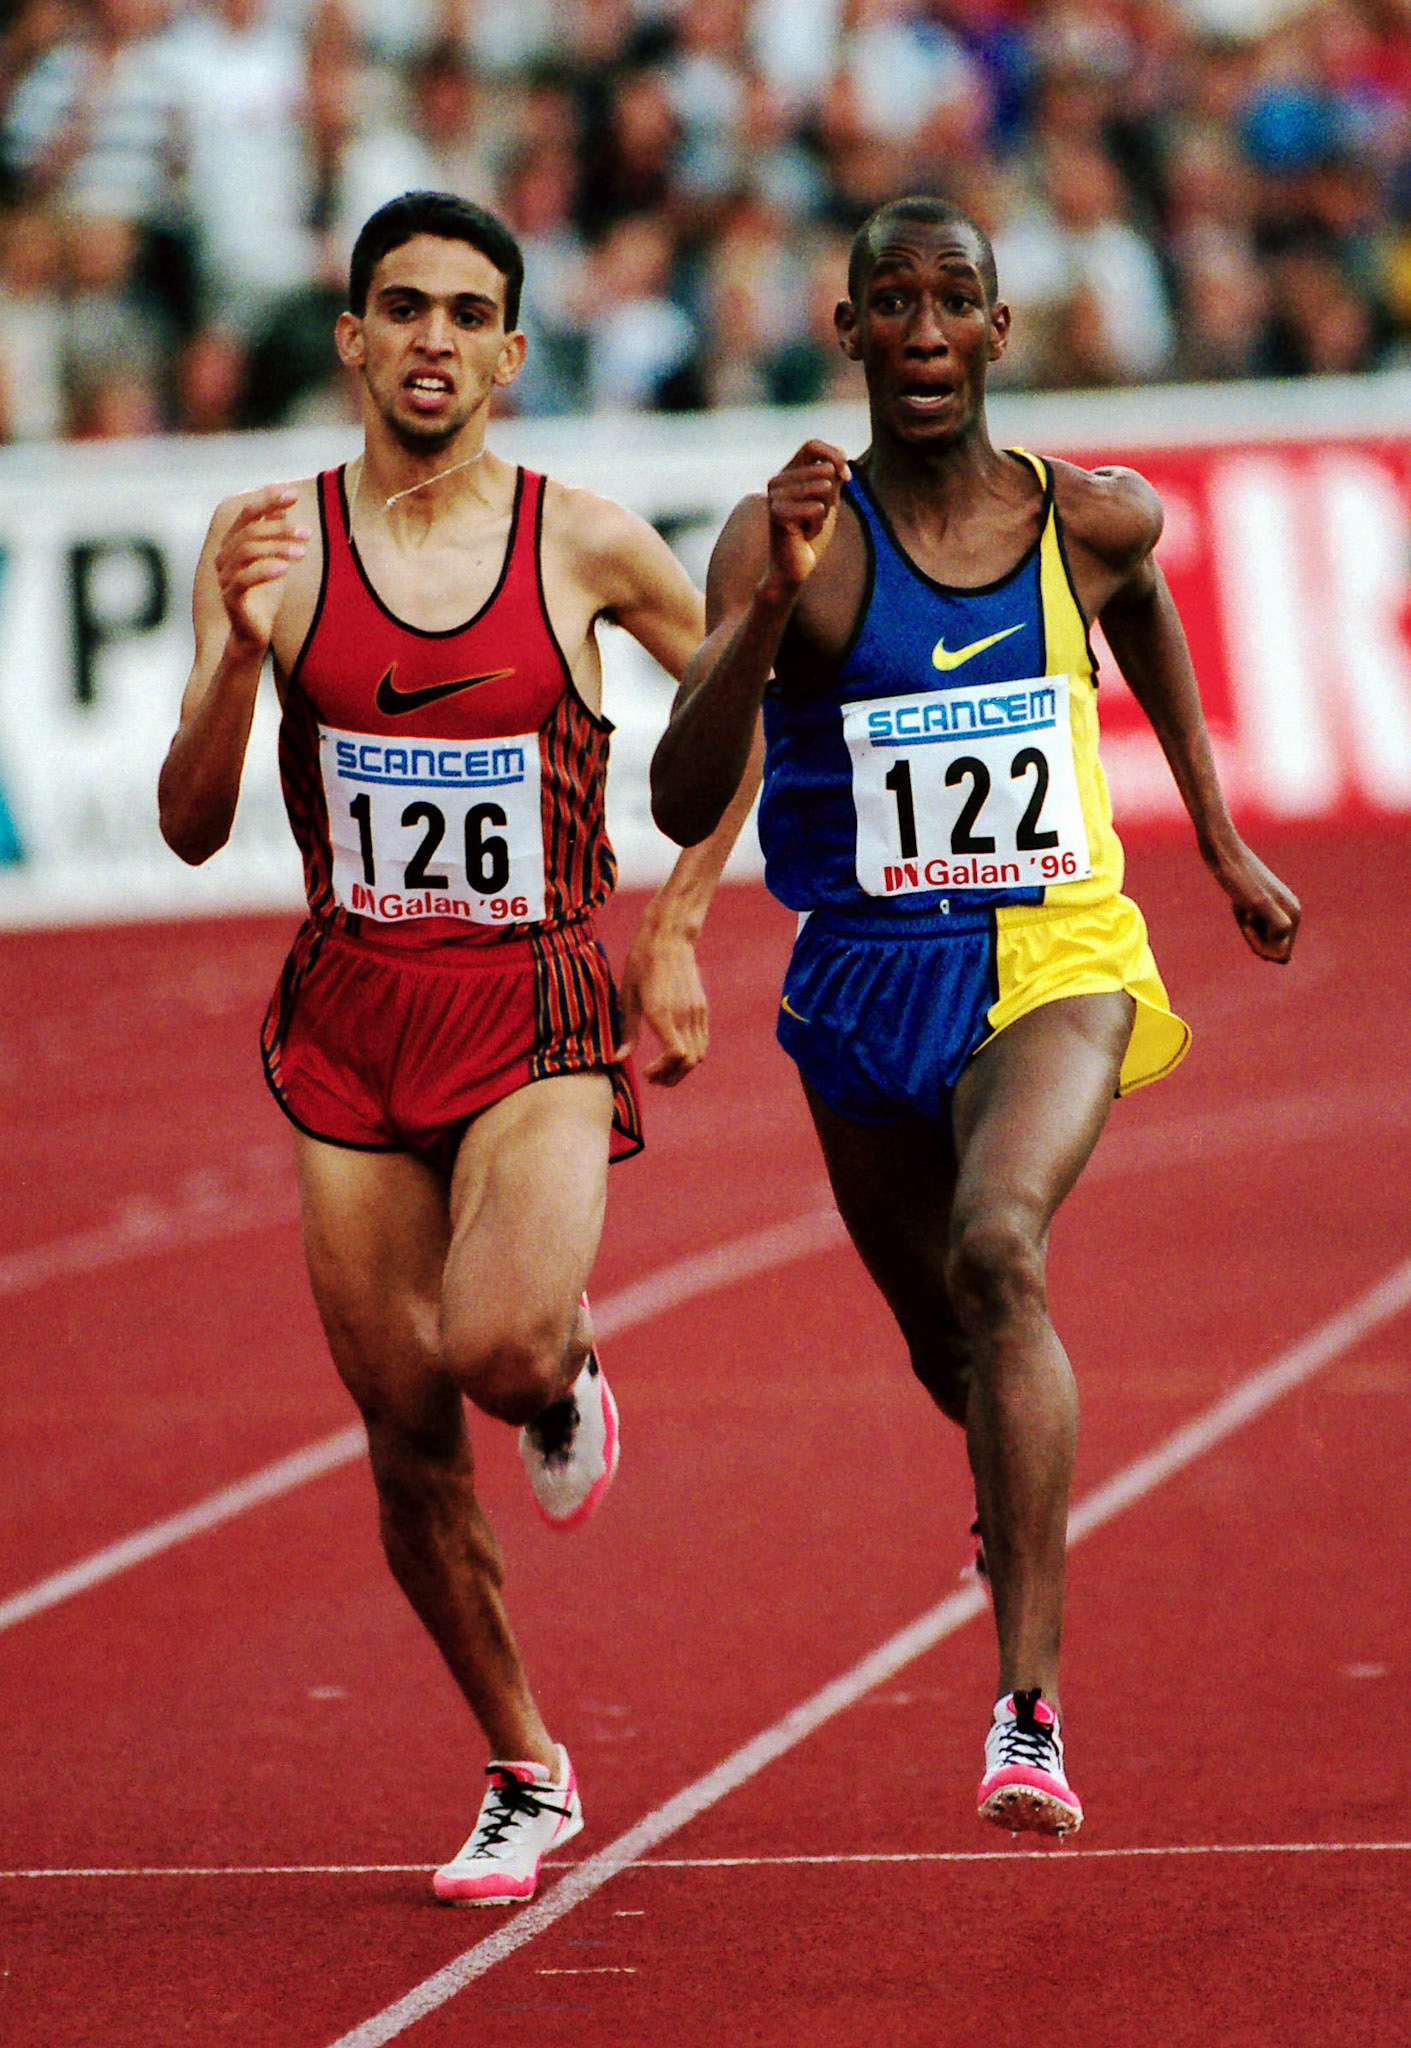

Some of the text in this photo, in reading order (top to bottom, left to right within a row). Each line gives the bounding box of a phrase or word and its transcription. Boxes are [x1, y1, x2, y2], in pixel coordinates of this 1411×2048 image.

[868, 689, 1055, 737] SCANCEM
[336, 740, 523, 777] SCANCEM
[885, 747, 1059, 859] 122
[349, 793, 509, 894] 126
[925, 858, 1019, 886] Galan
[1030, 851, 1076, 879] '96
[379, 892, 471, 918] Galan
[480, 896, 528, 919] '96
